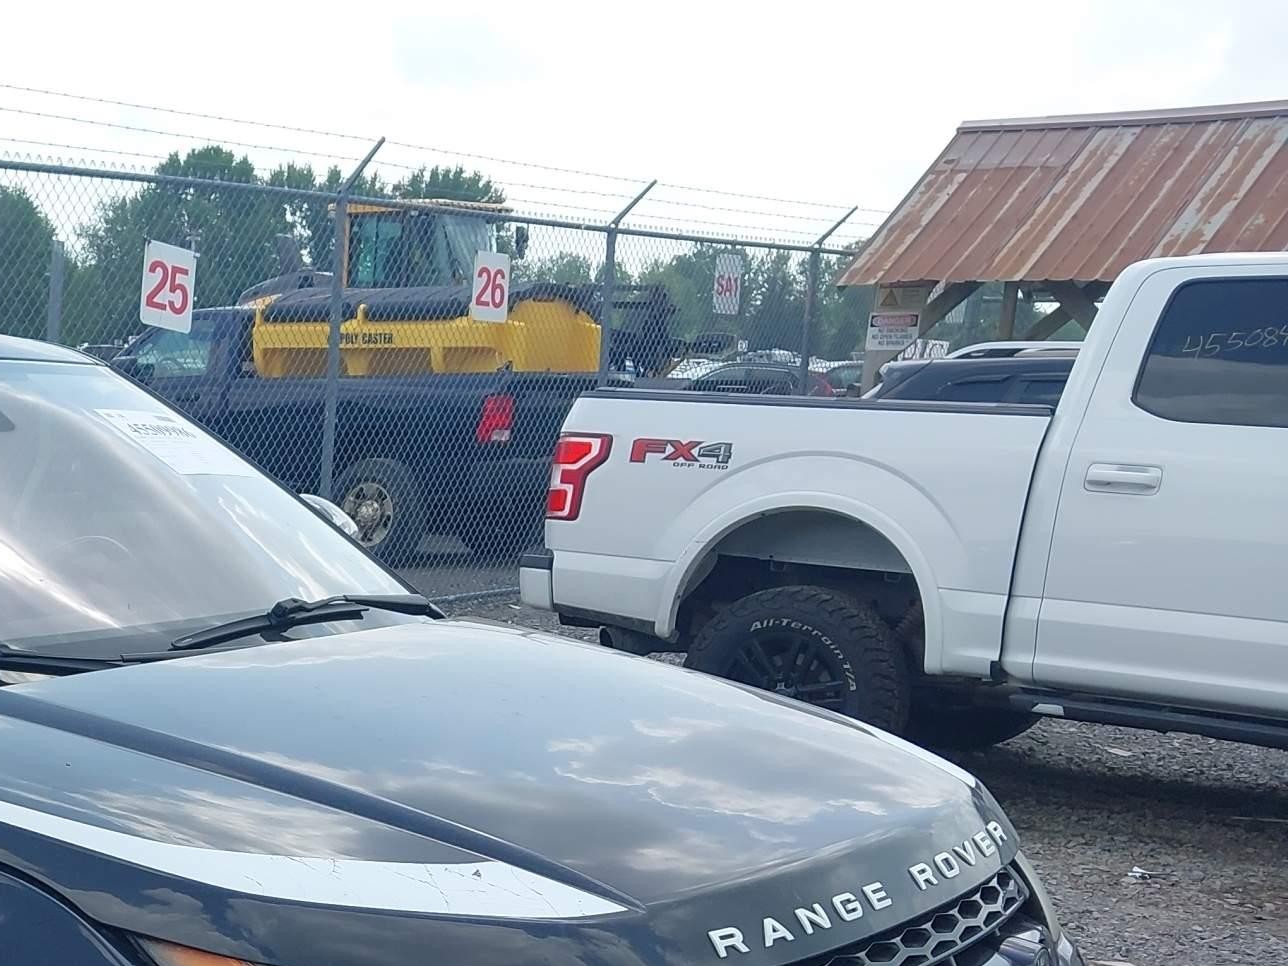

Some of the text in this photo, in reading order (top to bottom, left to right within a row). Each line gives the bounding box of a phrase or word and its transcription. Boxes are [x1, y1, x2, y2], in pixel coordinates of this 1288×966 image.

[145, 260, 189, 315] 25
[475, 266, 505, 309] 26
[362, 332, 393, 345] CASTER
[629, 438, 733, 464] FX4
[698, 462, 729, 470] ROAD
[749, 618, 844, 660] All-Terrain
[707, 820, 1008, 959] RANGE ROVER
